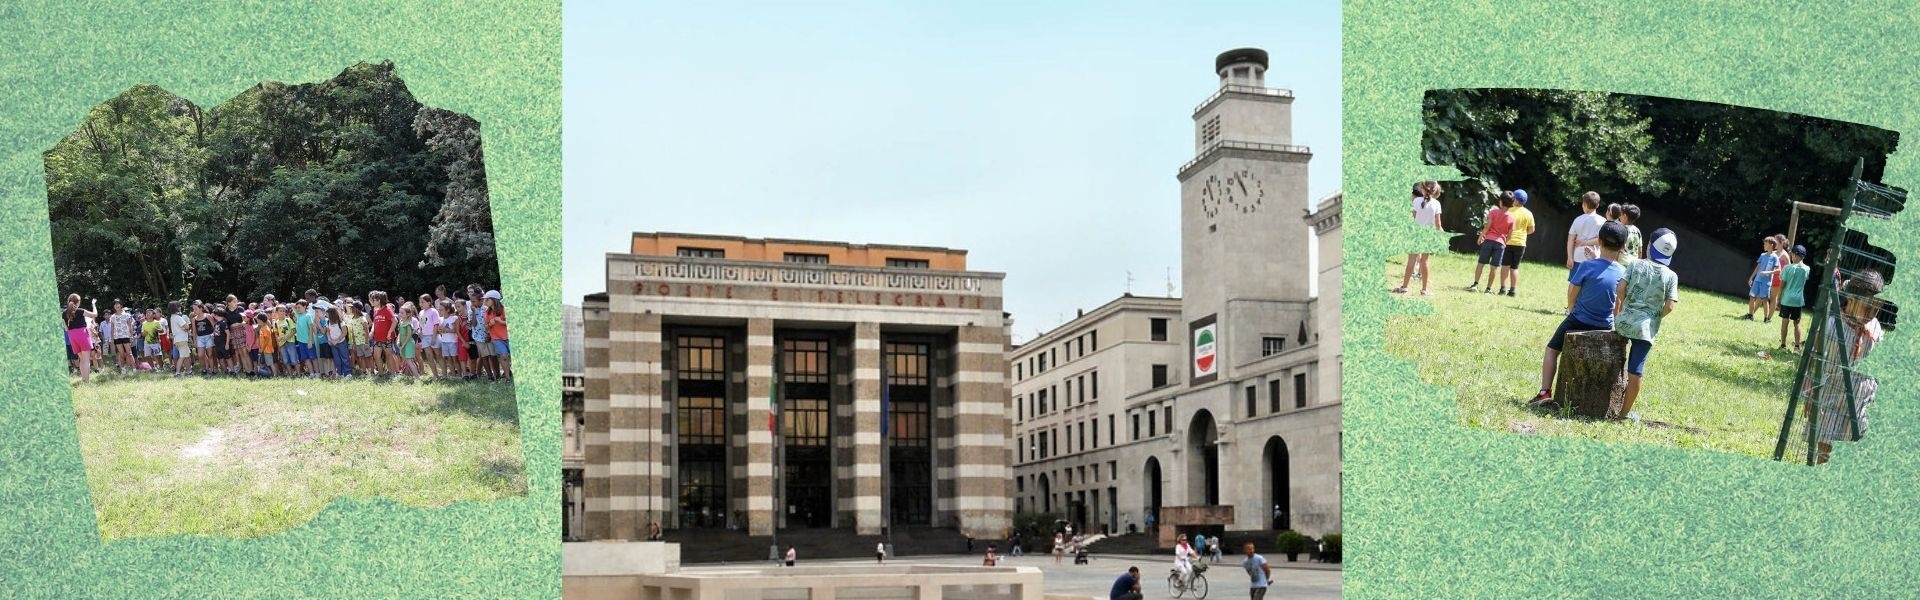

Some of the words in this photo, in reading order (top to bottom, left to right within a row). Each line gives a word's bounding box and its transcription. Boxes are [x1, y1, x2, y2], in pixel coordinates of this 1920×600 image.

[634, 281, 732, 299] POSTE
[772, 287, 779, 301] E
[816, 290, 982, 310] TELEGRAFI
